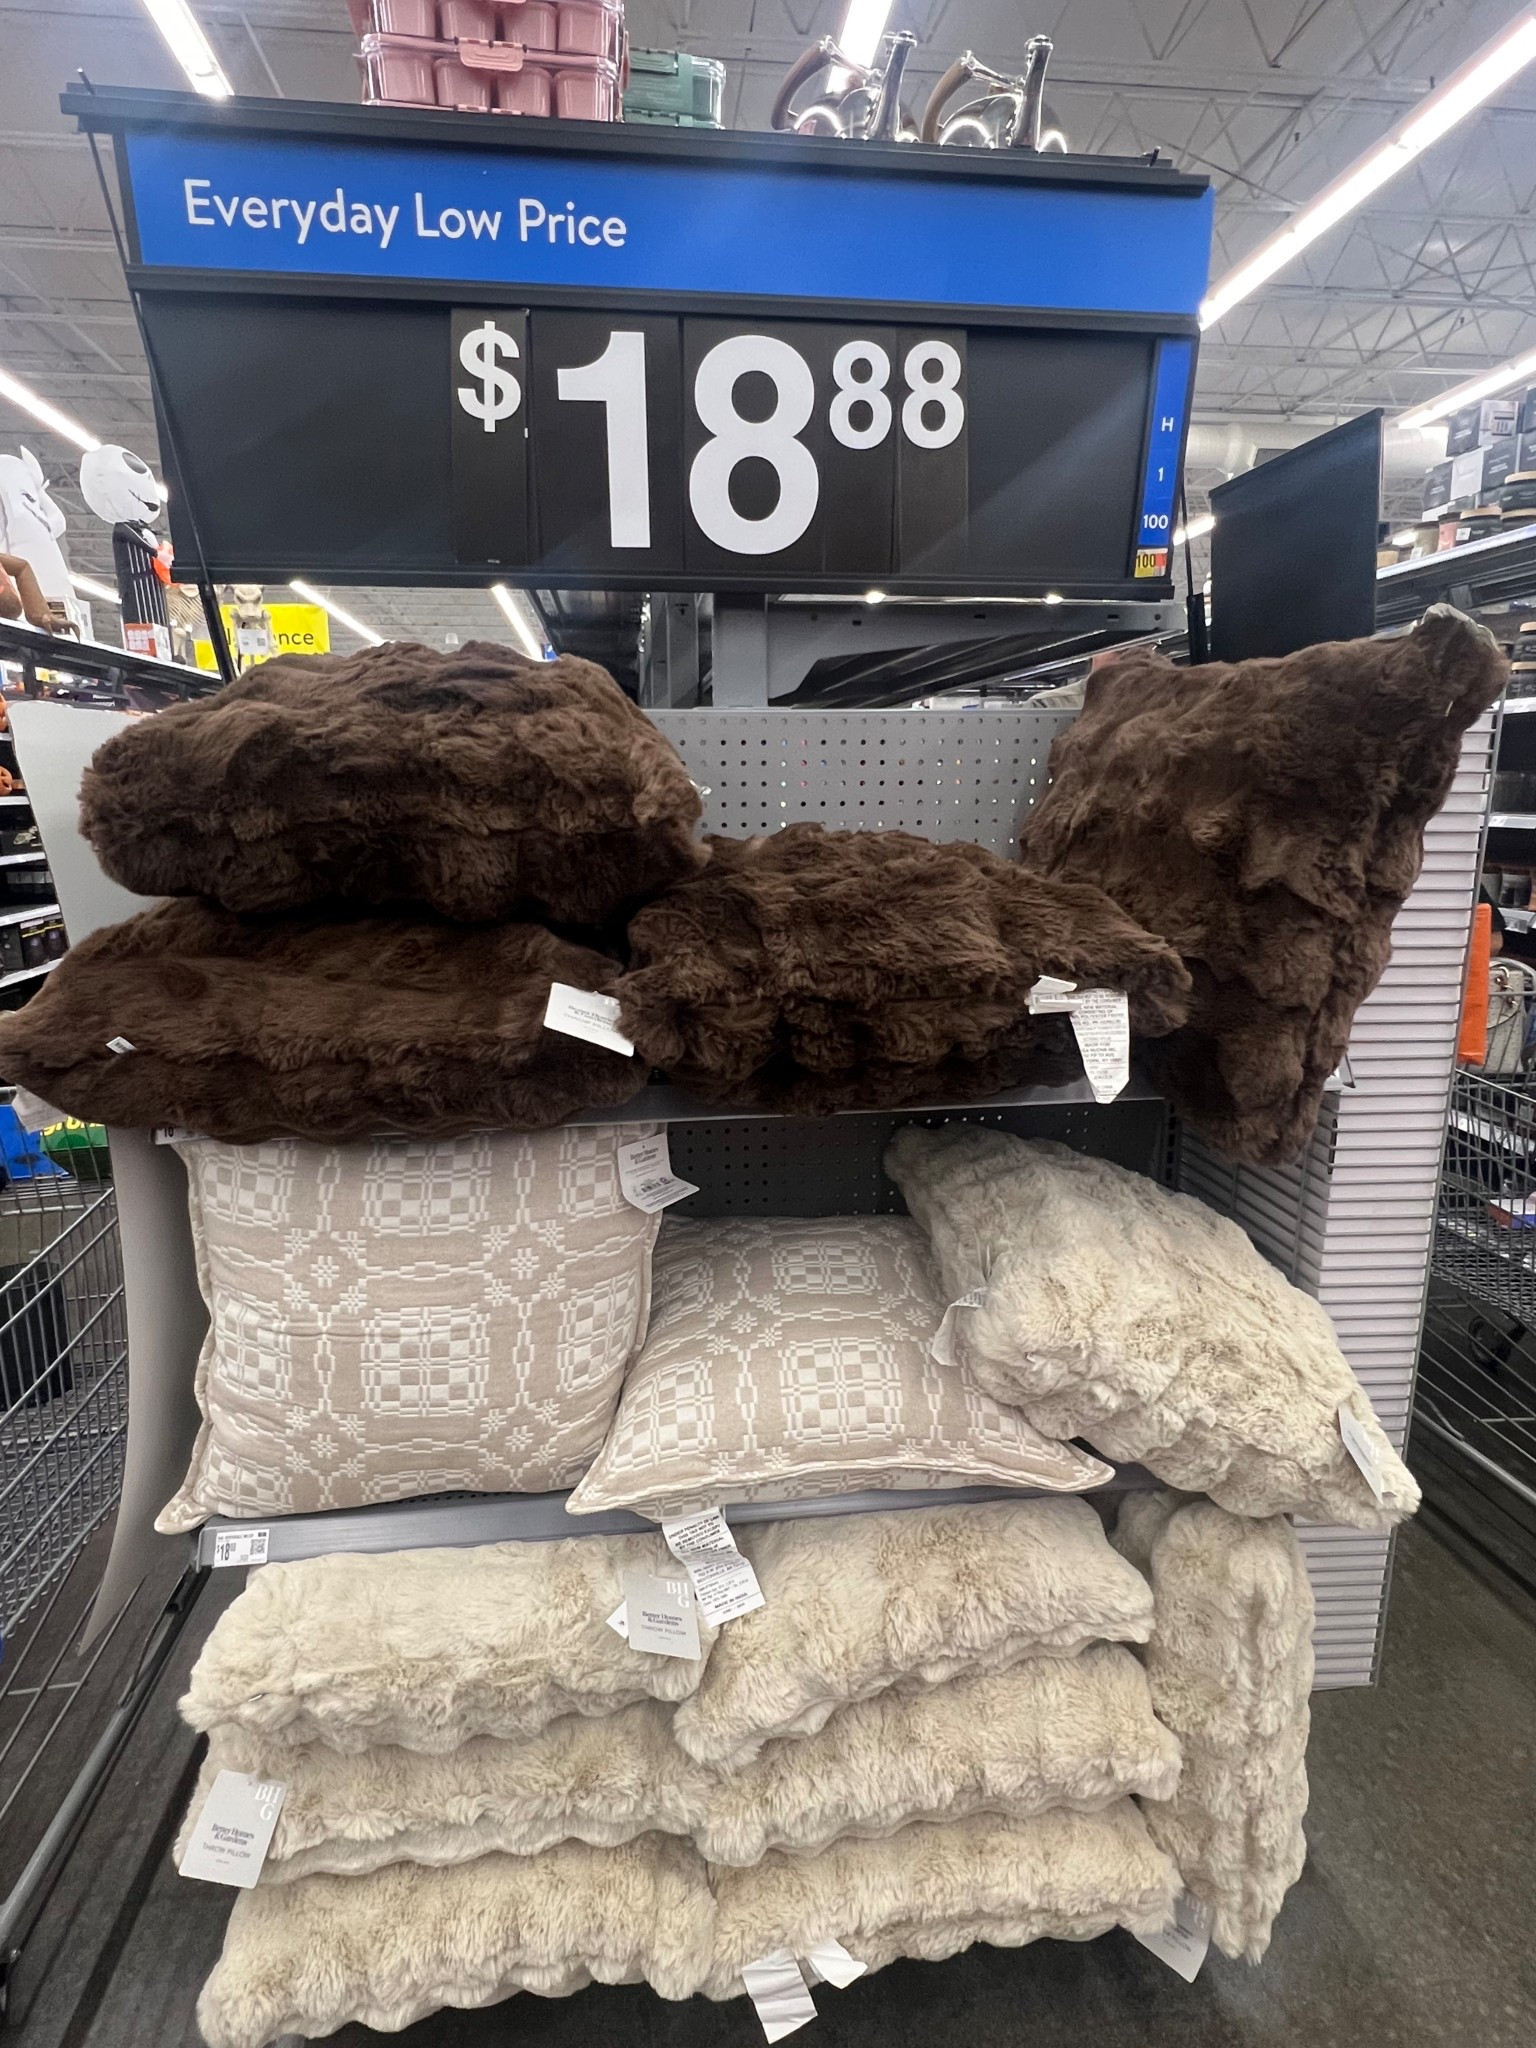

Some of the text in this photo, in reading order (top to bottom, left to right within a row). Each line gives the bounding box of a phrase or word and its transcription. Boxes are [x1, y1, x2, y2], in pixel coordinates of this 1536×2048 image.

[184, 178, 627, 249] Everyday Low Price
[1161, 417, 1174, 432] H
[1158, 467, 1164, 482] 1
[1143, 514, 1169, 529] 100
[1136, 553, 1156, 568] 100
